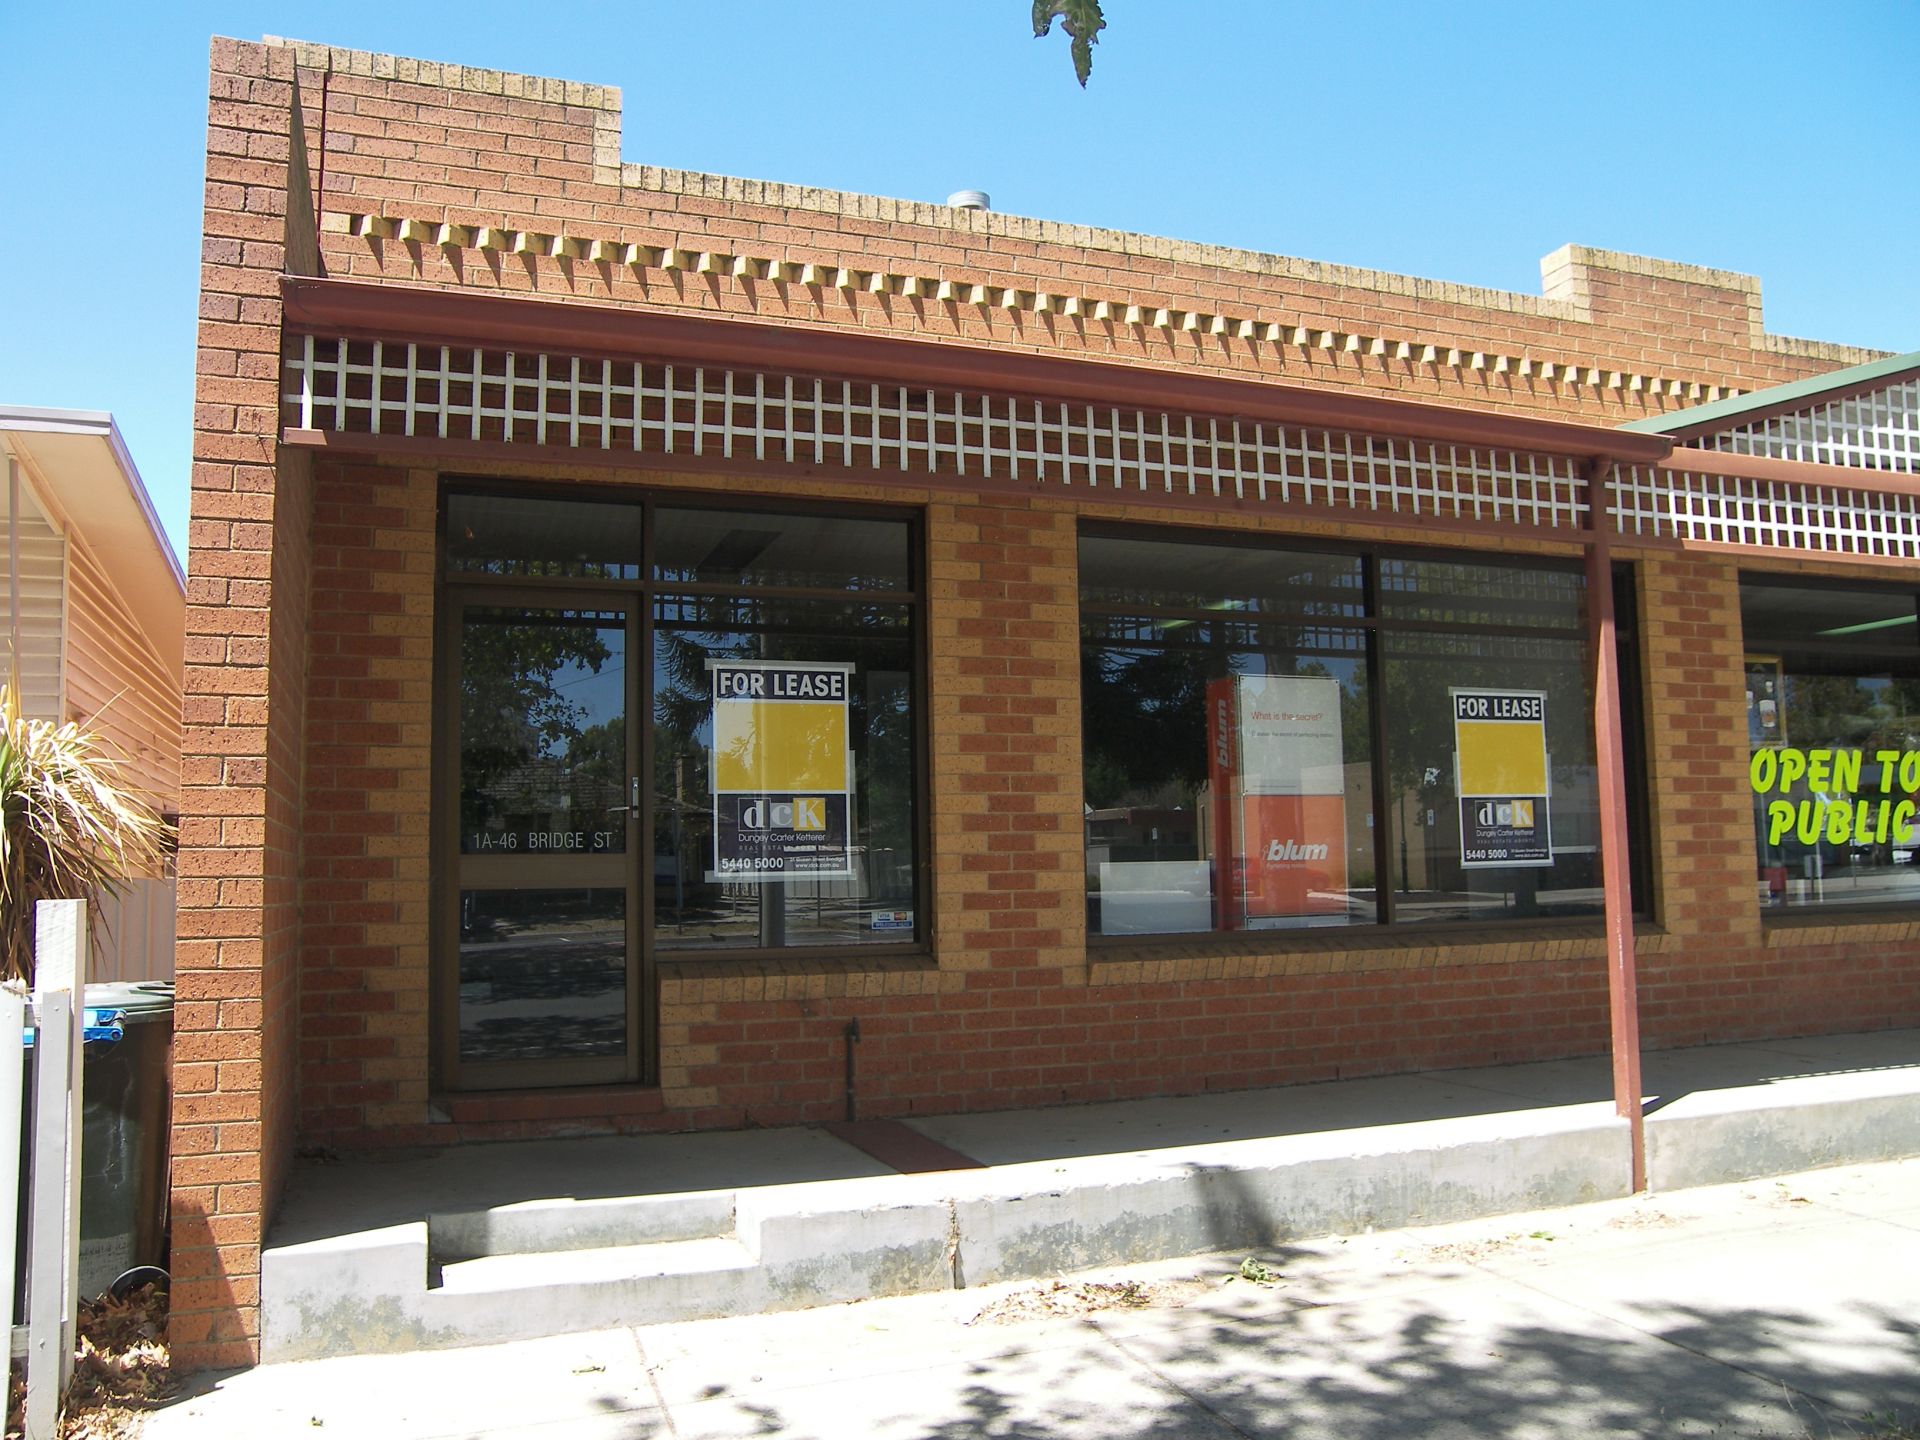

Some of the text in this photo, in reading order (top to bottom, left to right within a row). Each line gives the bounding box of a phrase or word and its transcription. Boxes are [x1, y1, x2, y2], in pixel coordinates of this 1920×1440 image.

[720, 672, 842, 697] FOR LEASE
[1458, 697, 1540, 718] FOR LEASE
[1750, 747, 1920, 794] OPEN TO
[1768, 799, 1916, 846] PUBLIC
[473, 832, 613, 849] 1A-46 BRIDGE ST
[770, 833, 795, 842] Carter
[1267, 839, 1328, 861] blum
[1466, 849, 1486, 859] 5440
[1487, 849, 1508, 859] 5000
[721, 857, 784, 869] 5440 5000
